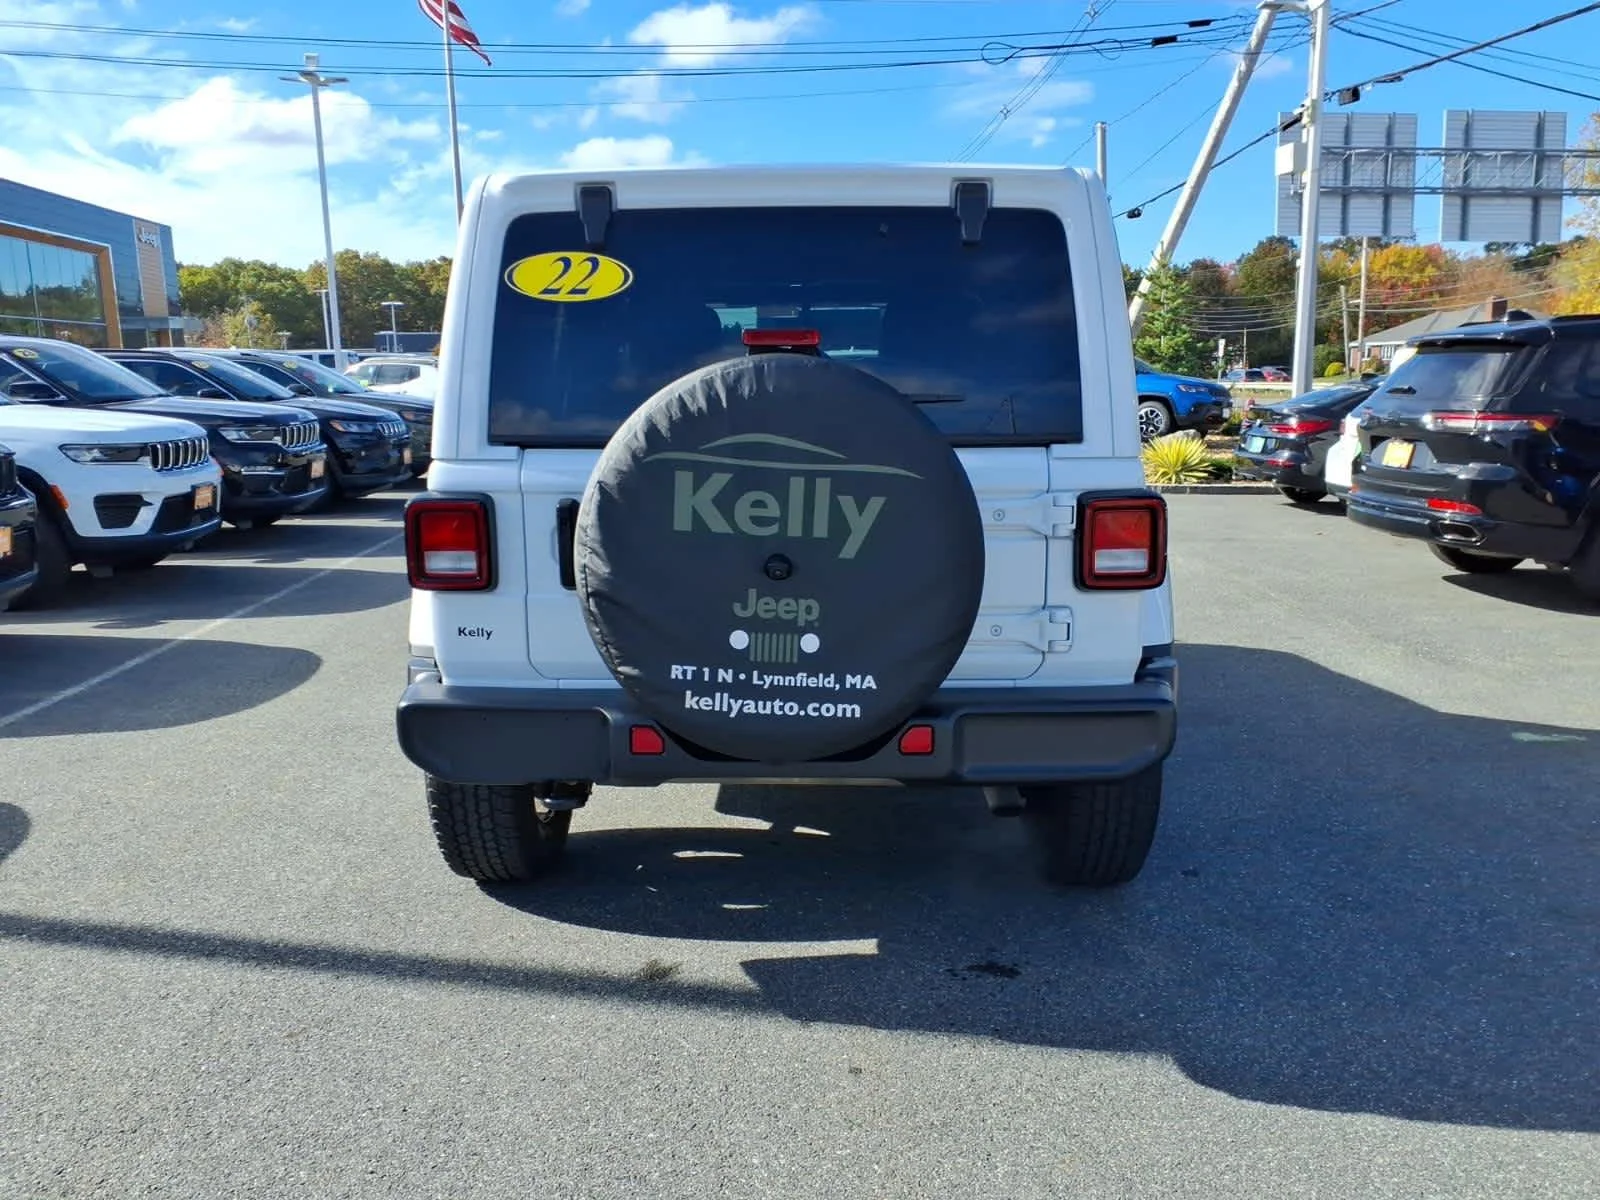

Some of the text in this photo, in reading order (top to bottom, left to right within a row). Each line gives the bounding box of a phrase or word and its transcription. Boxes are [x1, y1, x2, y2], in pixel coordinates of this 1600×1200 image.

[538, 256, 600, 295] 22
[672, 470, 887, 560] Kelly
[732, 587, 820, 626] Jeep
[457, 626, 493, 640] Kelly
[670, 664, 877, 691] RT 1 N Lynnfield, MA
[684, 690, 862, 718] kellyauto.com
